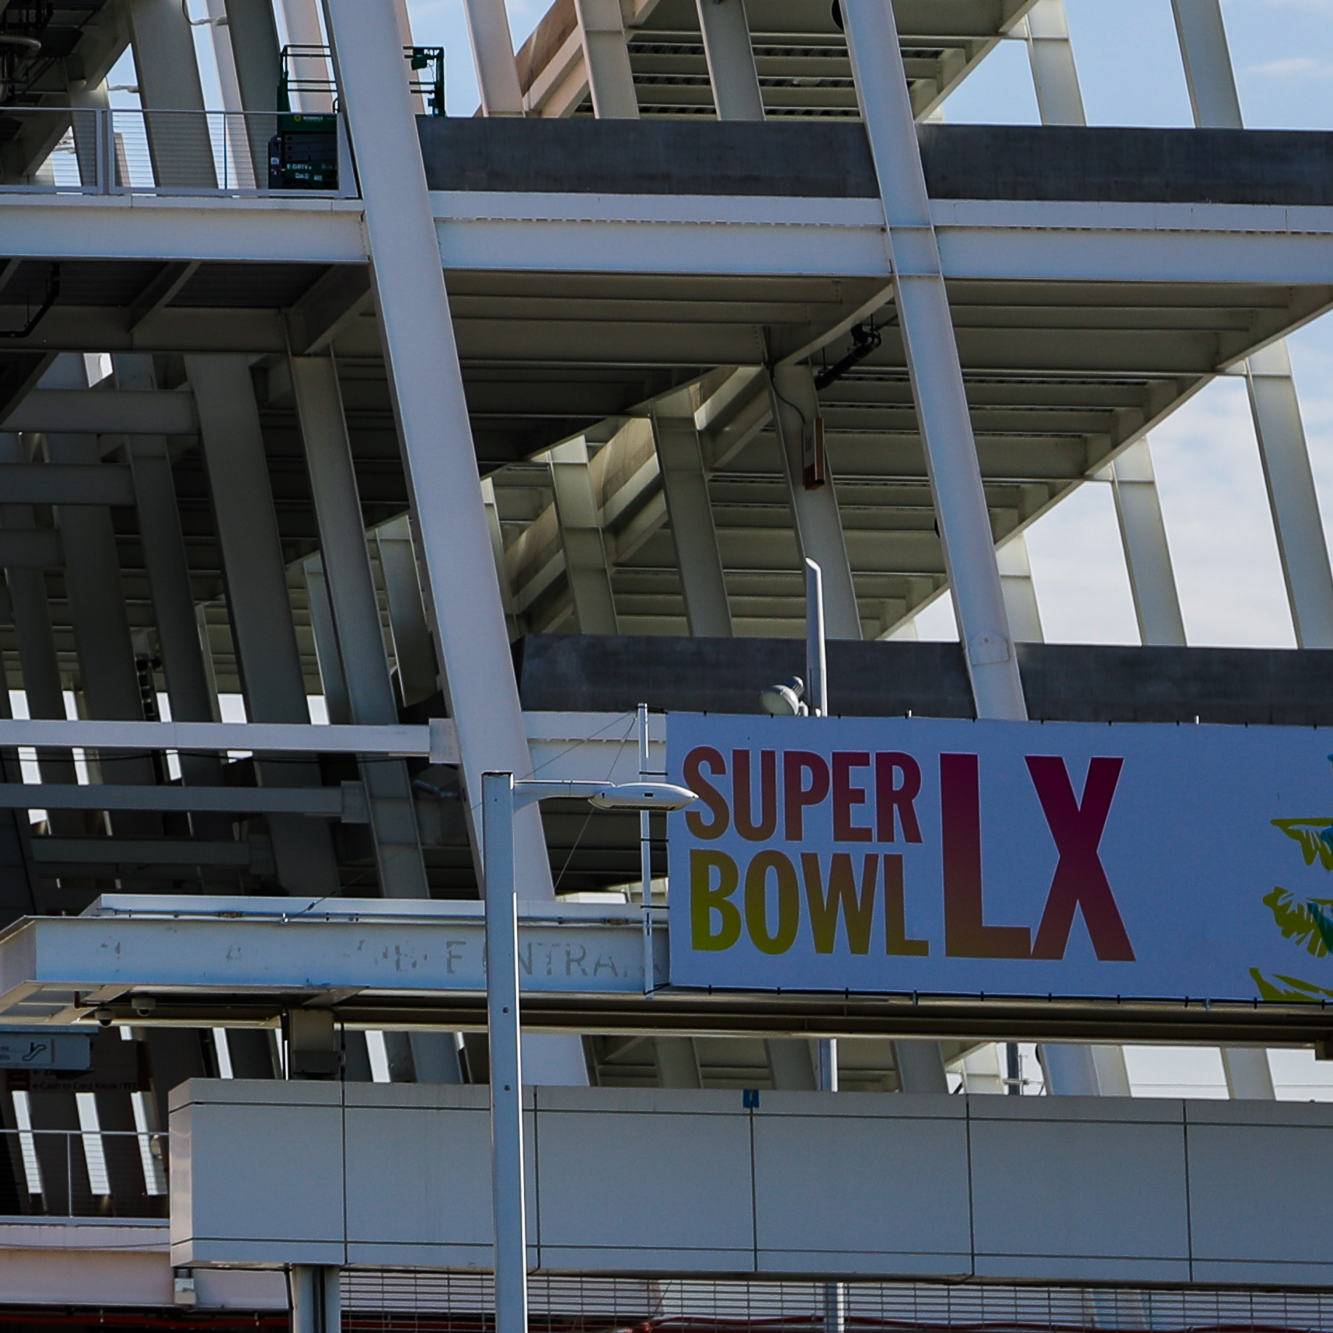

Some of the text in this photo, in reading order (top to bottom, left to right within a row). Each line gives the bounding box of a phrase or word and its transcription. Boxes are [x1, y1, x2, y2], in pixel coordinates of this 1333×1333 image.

[683, 746, 923, 844] SUPER
[689, 848, 930, 958] BOWL
[939, 752, 1137, 963] LX
